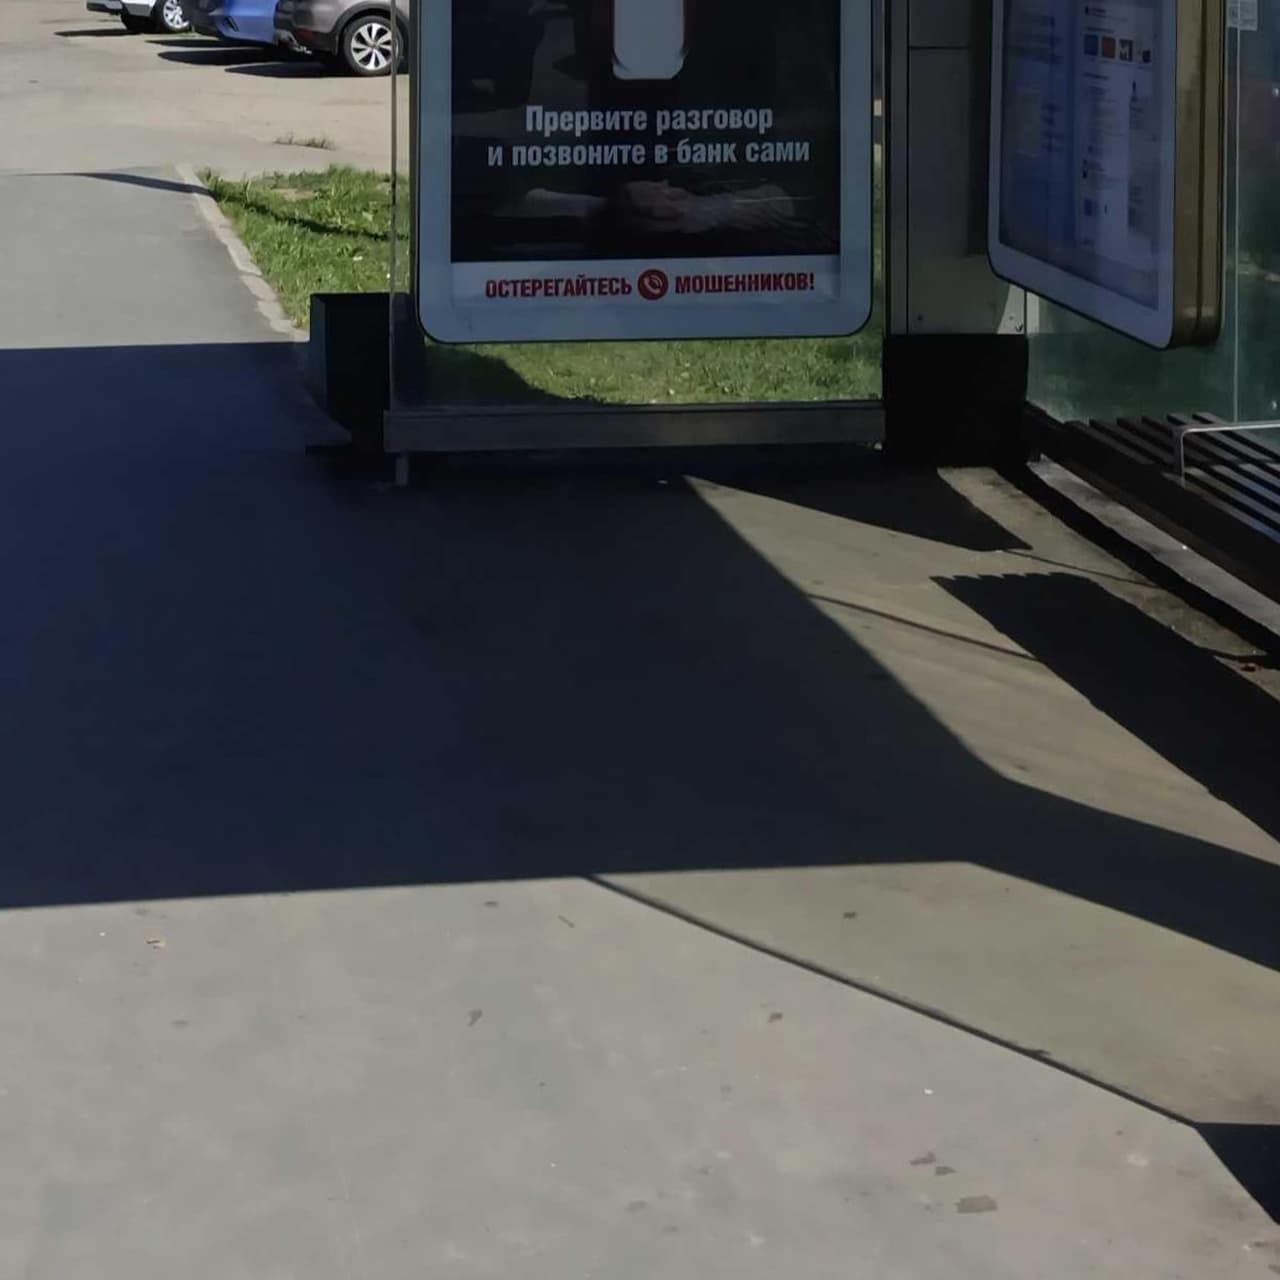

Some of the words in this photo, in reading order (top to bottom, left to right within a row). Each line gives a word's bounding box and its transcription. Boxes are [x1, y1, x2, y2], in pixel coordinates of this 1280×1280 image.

[526, 105, 647, 137] Прервите
[656, 107, 773, 136] разговор
[487, 145, 503, 166] и
[512, 143, 646, 167] позвоните
[654, 144, 668, 164] в
[677, 138, 737, 165] банк
[745, 140, 810, 163] сами
[485, 274, 633, 298] ОСТЕРЕГАЙТЕСЬ
[675, 272, 815, 294] МОШЕННИКОВ!
